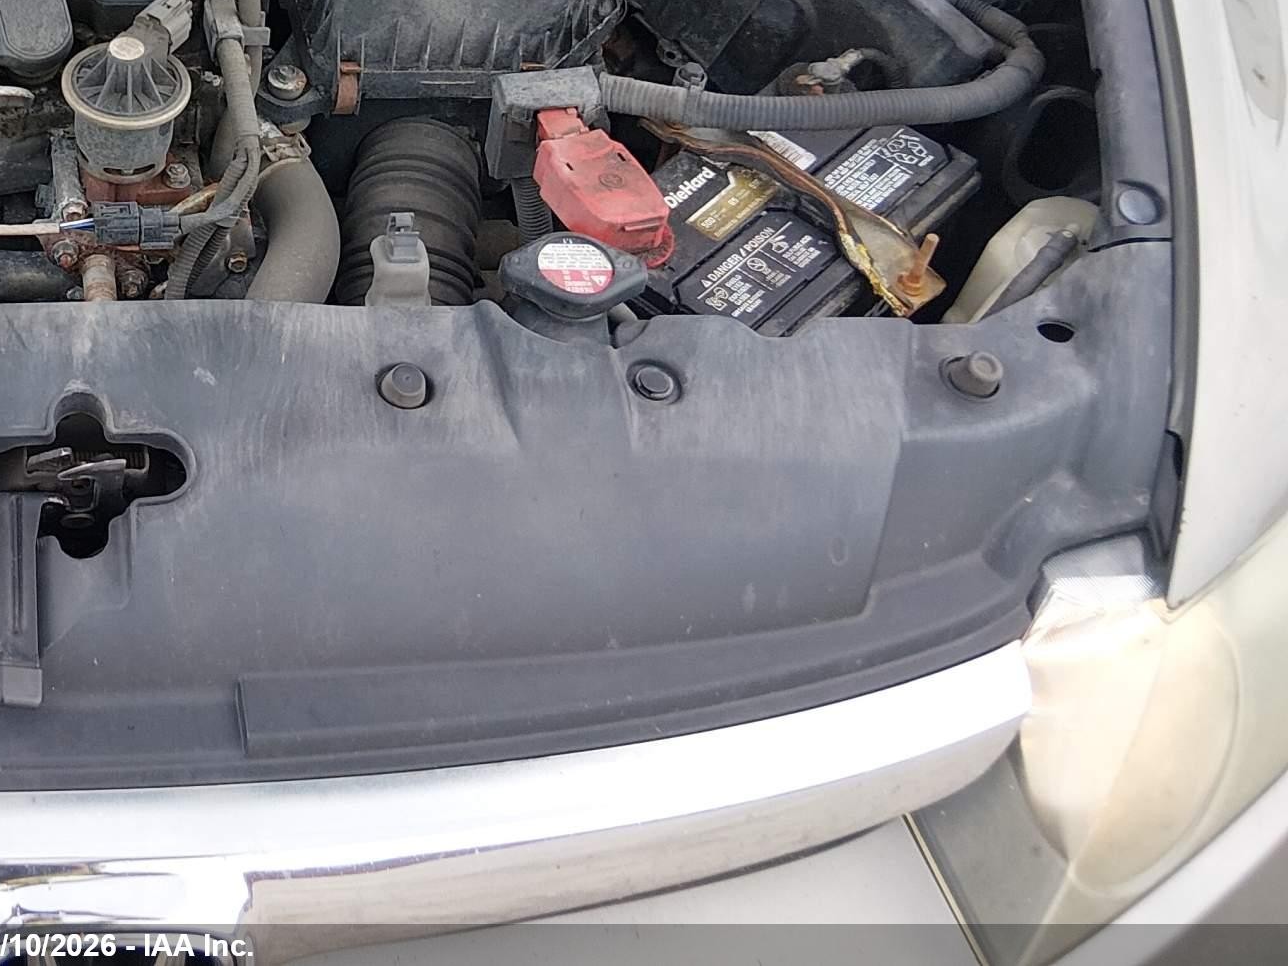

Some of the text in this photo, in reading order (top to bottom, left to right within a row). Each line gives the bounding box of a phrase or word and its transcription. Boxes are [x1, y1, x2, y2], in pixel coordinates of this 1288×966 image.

[663, 166, 717, 209] DieHard
[707, 253, 743, 282] DANGER
[743, 226, 776, 252] POISON
